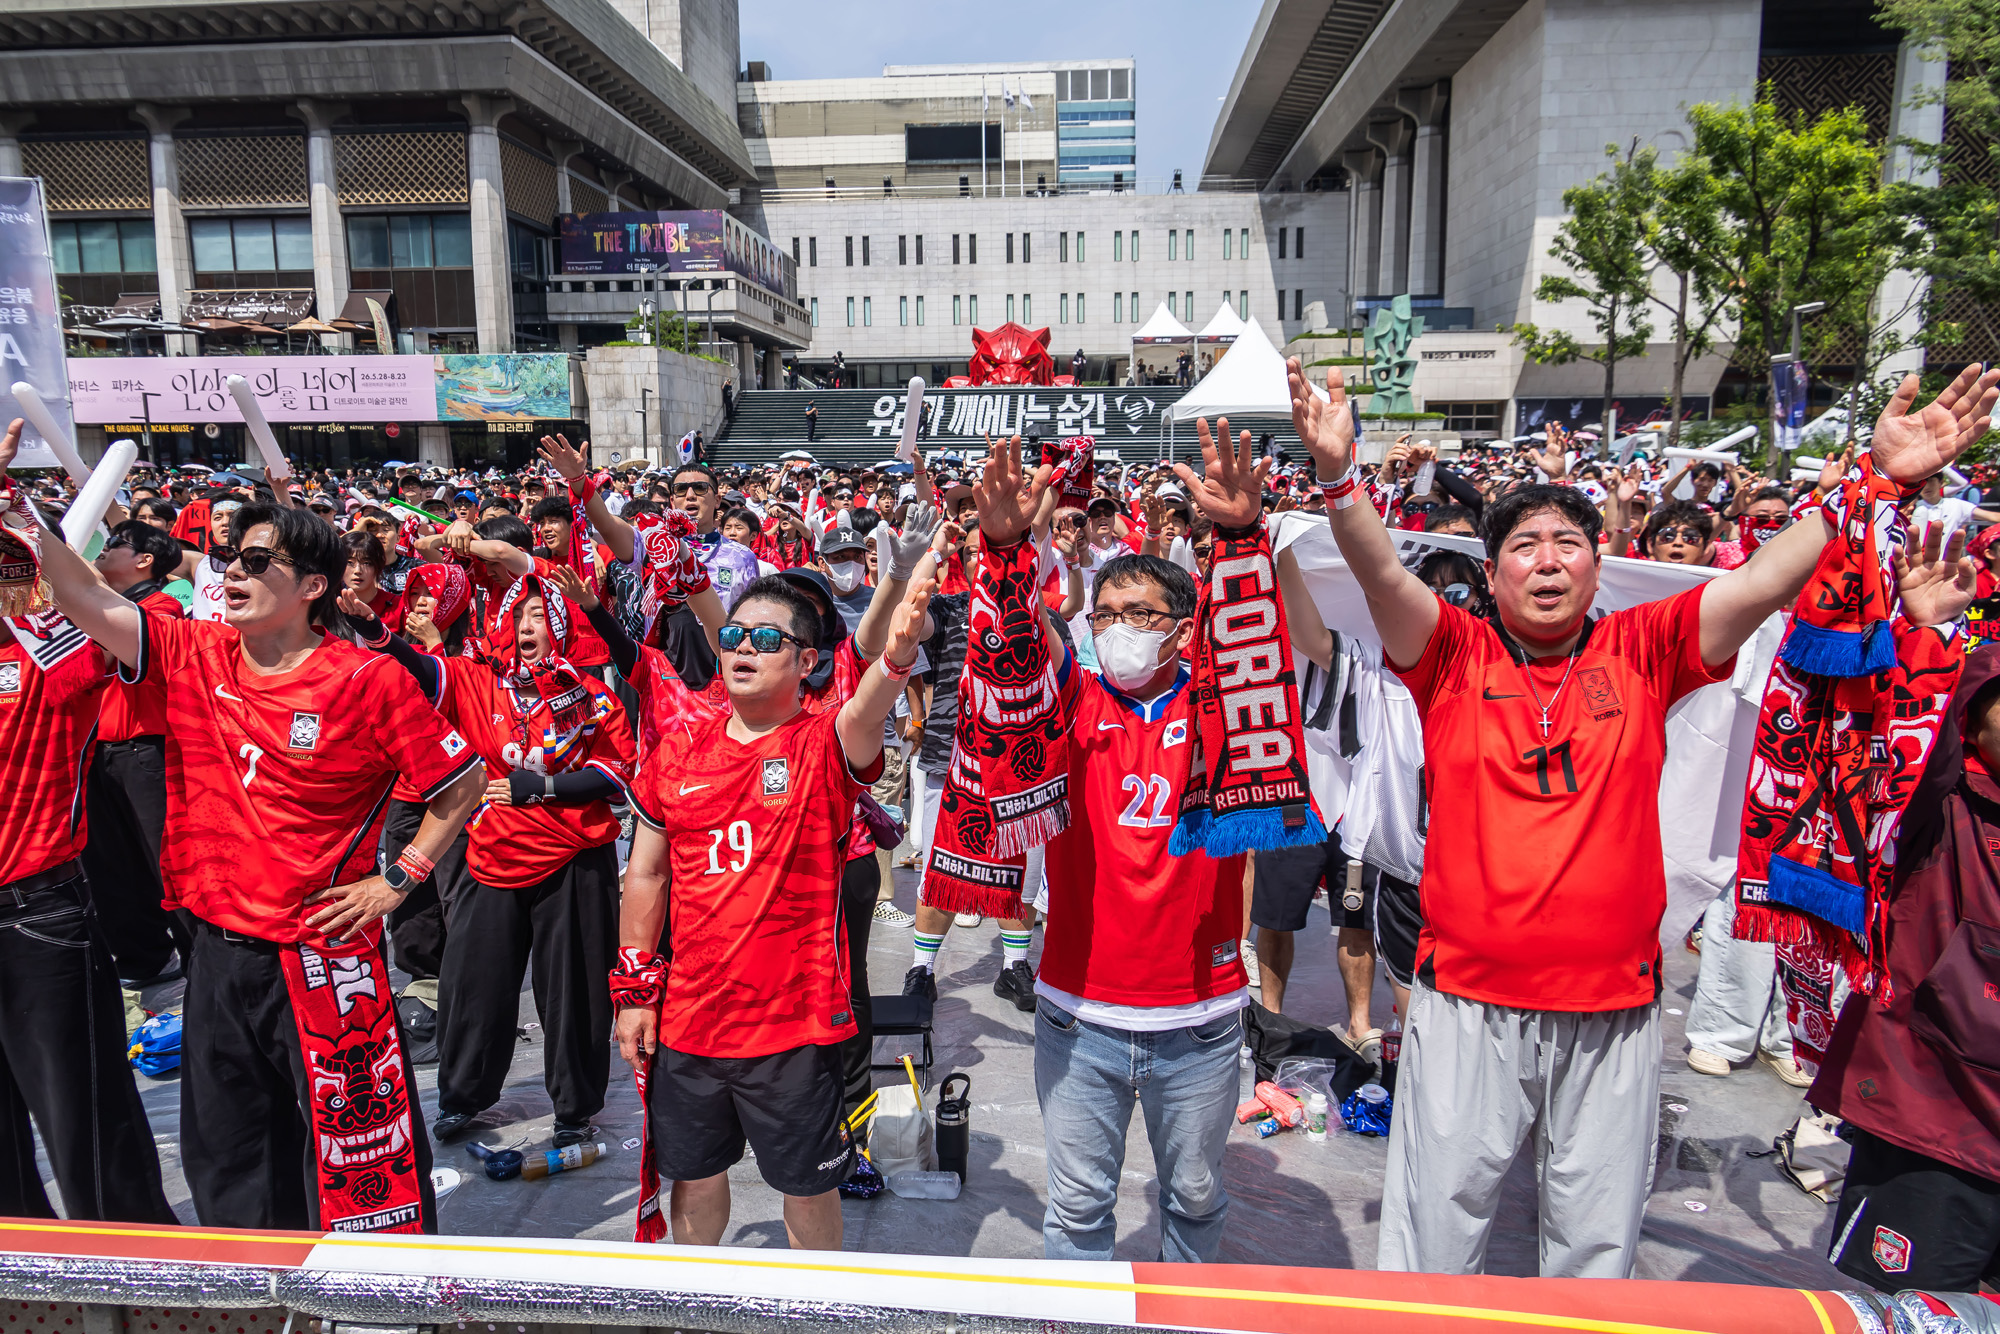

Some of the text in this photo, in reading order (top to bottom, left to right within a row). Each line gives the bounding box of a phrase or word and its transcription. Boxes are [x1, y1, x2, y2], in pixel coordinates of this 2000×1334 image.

[593, 222, 690, 254] THE TRIBE
[626, 263, 633, 271] 더
[69, 379, 145, 392] 마티스 피카소
[171, 367, 357, 411] 인상의를 넘어
[334, 397, 366, 405] 디트로이트
[367, 397, 387, 405] 미술관
[947, 394, 1051, 436] 깨어나는
[1056, 394, 1108, 436] 순간
[2, 564, 36, 578] FORZA
[1211, 553, 1294, 772] COREA
[0, 696, 20, 705] OREA
[1593, 708, 1624, 723] KOREA
[239, 743, 265, 789] 7
[286, 752, 314, 762] KOREA
[501, 742, 548, 777] 94
[1522, 739, 1579, 795] 11
[763, 798, 789, 809] KOREA
[1118, 773, 1173, 828] 22
[1215, 785, 1249, 812] RED
[1250, 781, 1306, 804] DEVIL
[704, 820, 753, 876] 19
[299, 943, 328, 989] OREA
